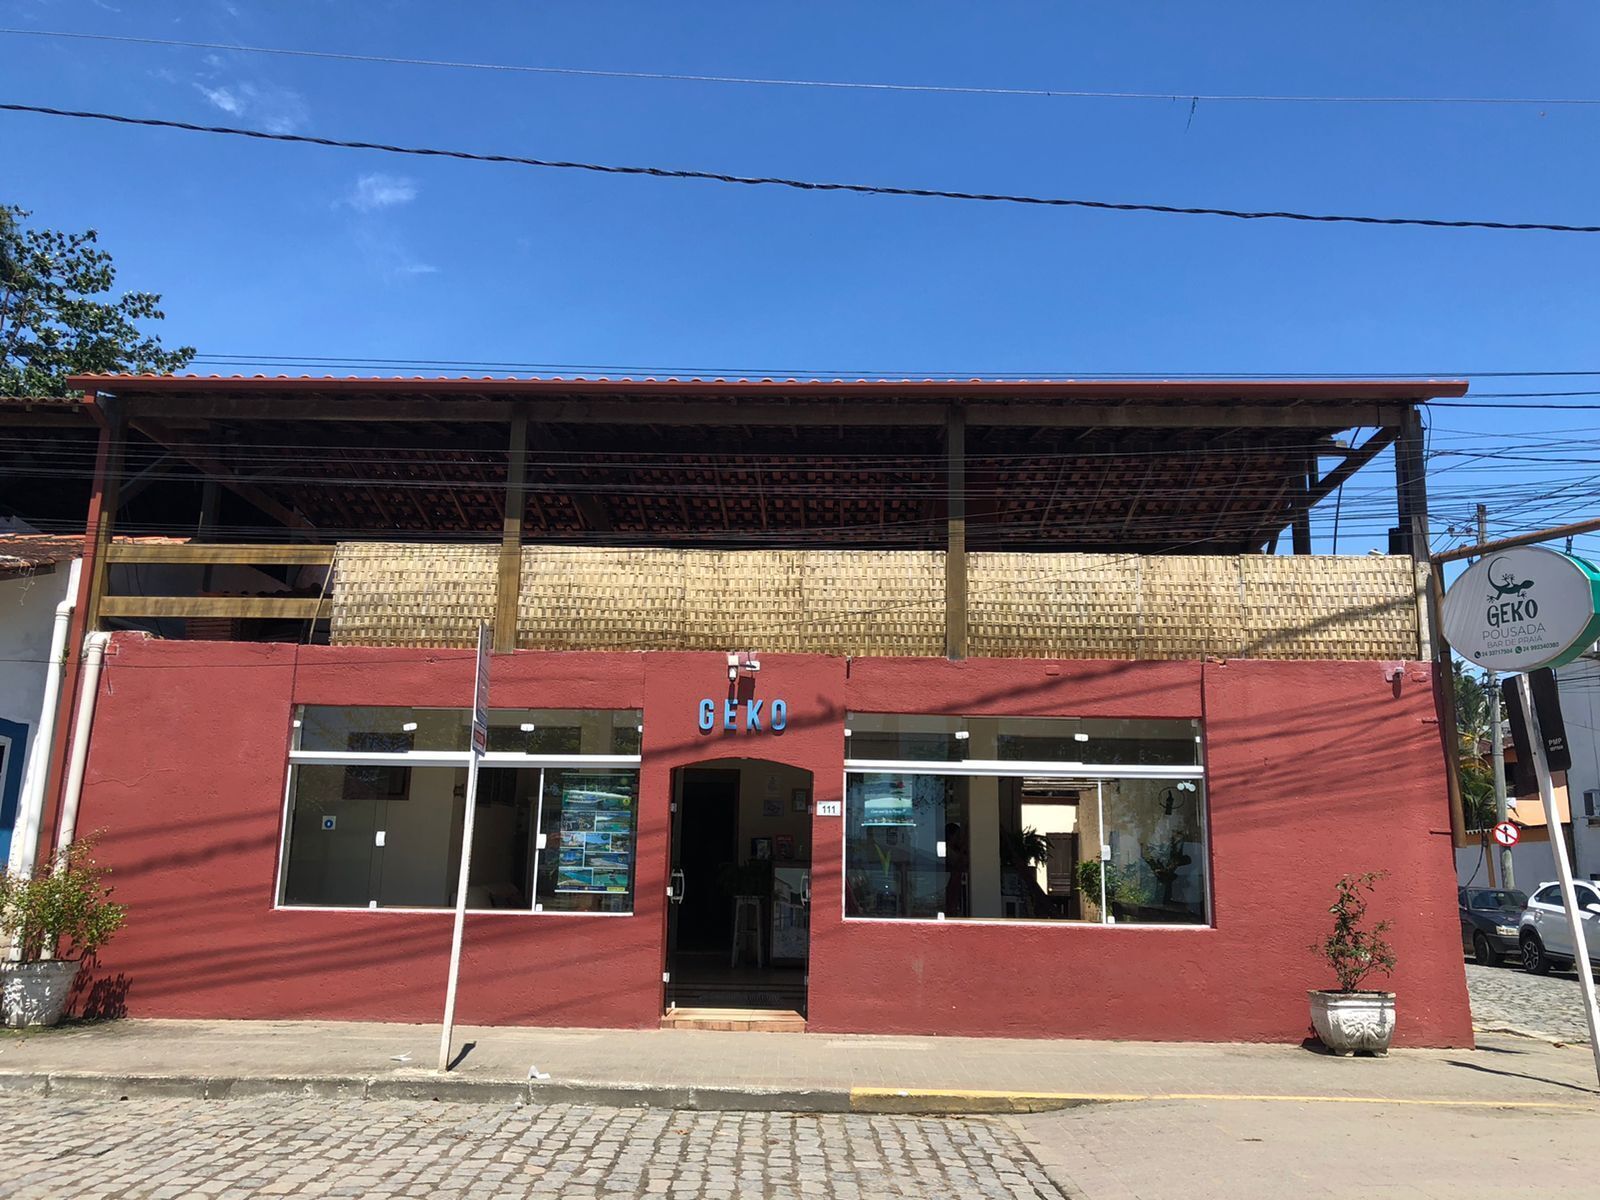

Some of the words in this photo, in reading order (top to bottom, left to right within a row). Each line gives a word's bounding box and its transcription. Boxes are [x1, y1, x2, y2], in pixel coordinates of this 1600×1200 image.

[1486, 598, 1538, 628] GEKO
[1482, 622, 1546, 641] POUSADA
[1487, 640, 1504, 649] BAR
[1505, 639, 1517, 647] DE
[1518, 635, 1543, 645] PRAIA
[699, 698, 787, 731] GEKO
[822, 805, 836, 814] 111
